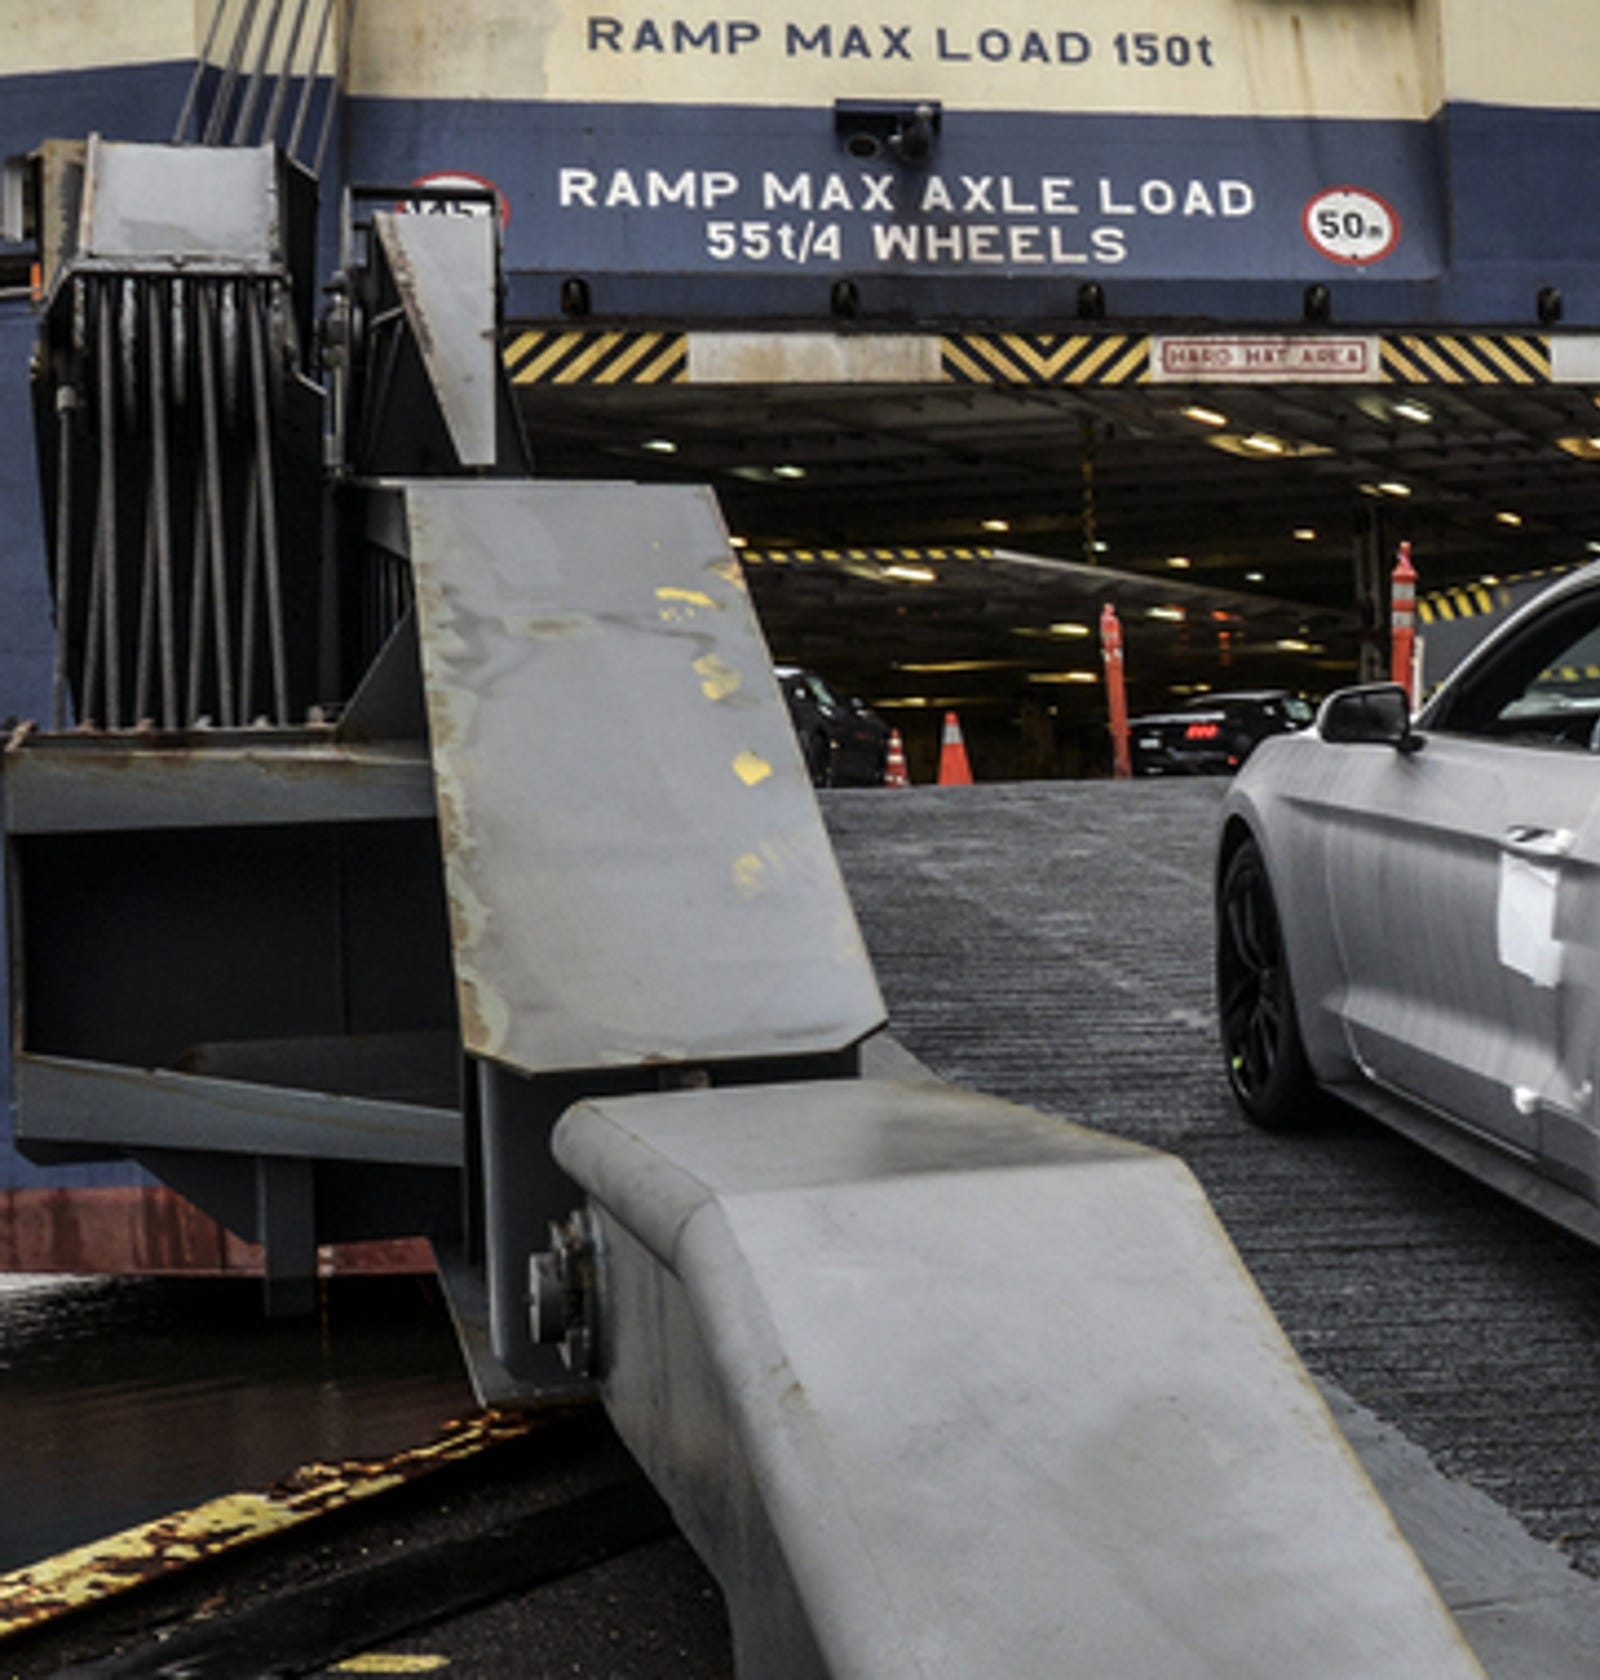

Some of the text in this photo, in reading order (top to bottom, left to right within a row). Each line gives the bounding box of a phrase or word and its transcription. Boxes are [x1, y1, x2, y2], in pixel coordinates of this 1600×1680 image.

[587, 16, 1214, 67] RAMP MAX LOAD 150t
[559, 168, 1254, 216] RAMP MAX AXLE LOAD
[706, 220, 1127, 264] 55t/4 WHEELS
[1169, 347, 1359, 366] HARD HAT AREA
